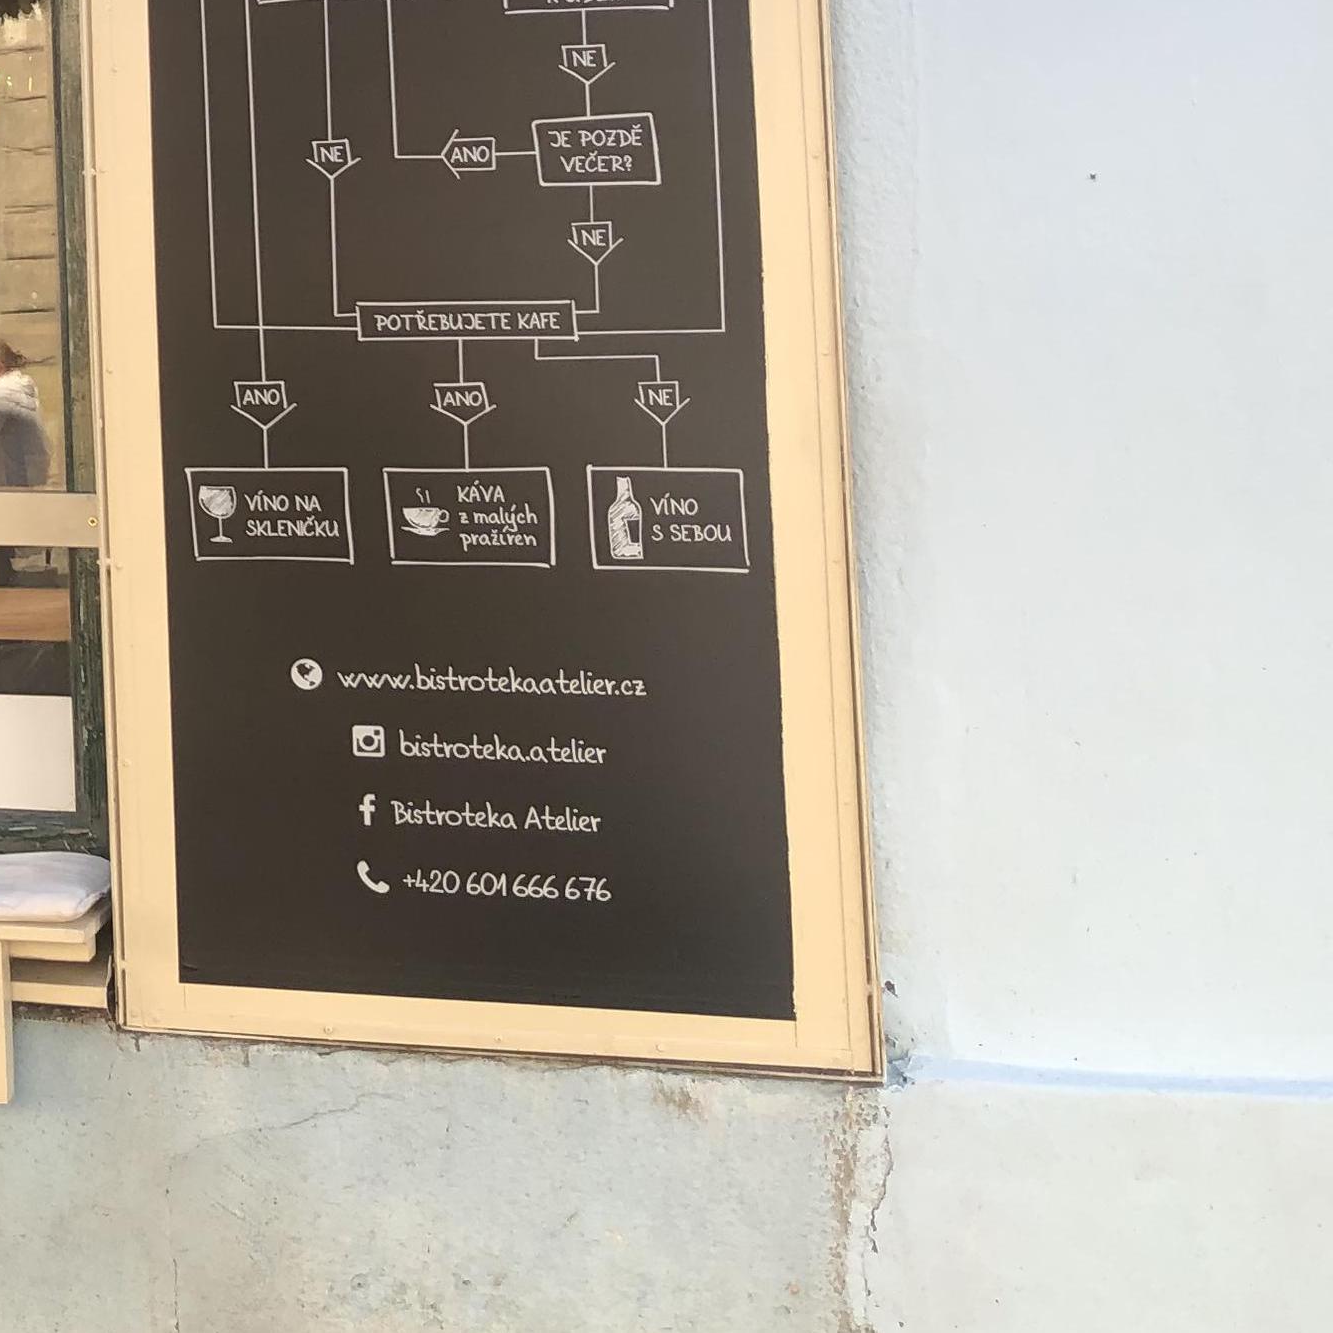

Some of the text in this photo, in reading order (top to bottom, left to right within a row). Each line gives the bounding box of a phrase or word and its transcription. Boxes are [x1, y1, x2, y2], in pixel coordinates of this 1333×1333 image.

[571, 49, 597, 67] NE
[547, 123, 643, 148] JE POZDĚ
[319, 145, 344, 163] NE
[450, 145, 490, 164] ANO
[559, 150, 633, 173] VEČER?
[580, 229, 606, 247] NE
[373, 309, 561, 331] POTŘEBUJETE KAFE
[242, 388, 281, 406] ANO
[442, 390, 483, 407] ANO
[647, 388, 673, 406] NE
[244, 489, 322, 512] VÍNO NA
[456, 480, 505, 503] KÁVA
[649, 492, 699, 516] VÍNO
[245, 515, 340, 537] SKLENIČKU
[458, 502, 538, 531] z malých
[459, 528, 537, 552] pražíren
[651, 524, 732, 542] S SEBOU
[337, 663, 647, 696] www.bistrotekaatelier.cz
[398, 729, 607, 764] bistroteka.atelier
[390, 799, 601, 832] Bistroteka Atelier
[402, 869, 612, 902] +420 601 666 676
